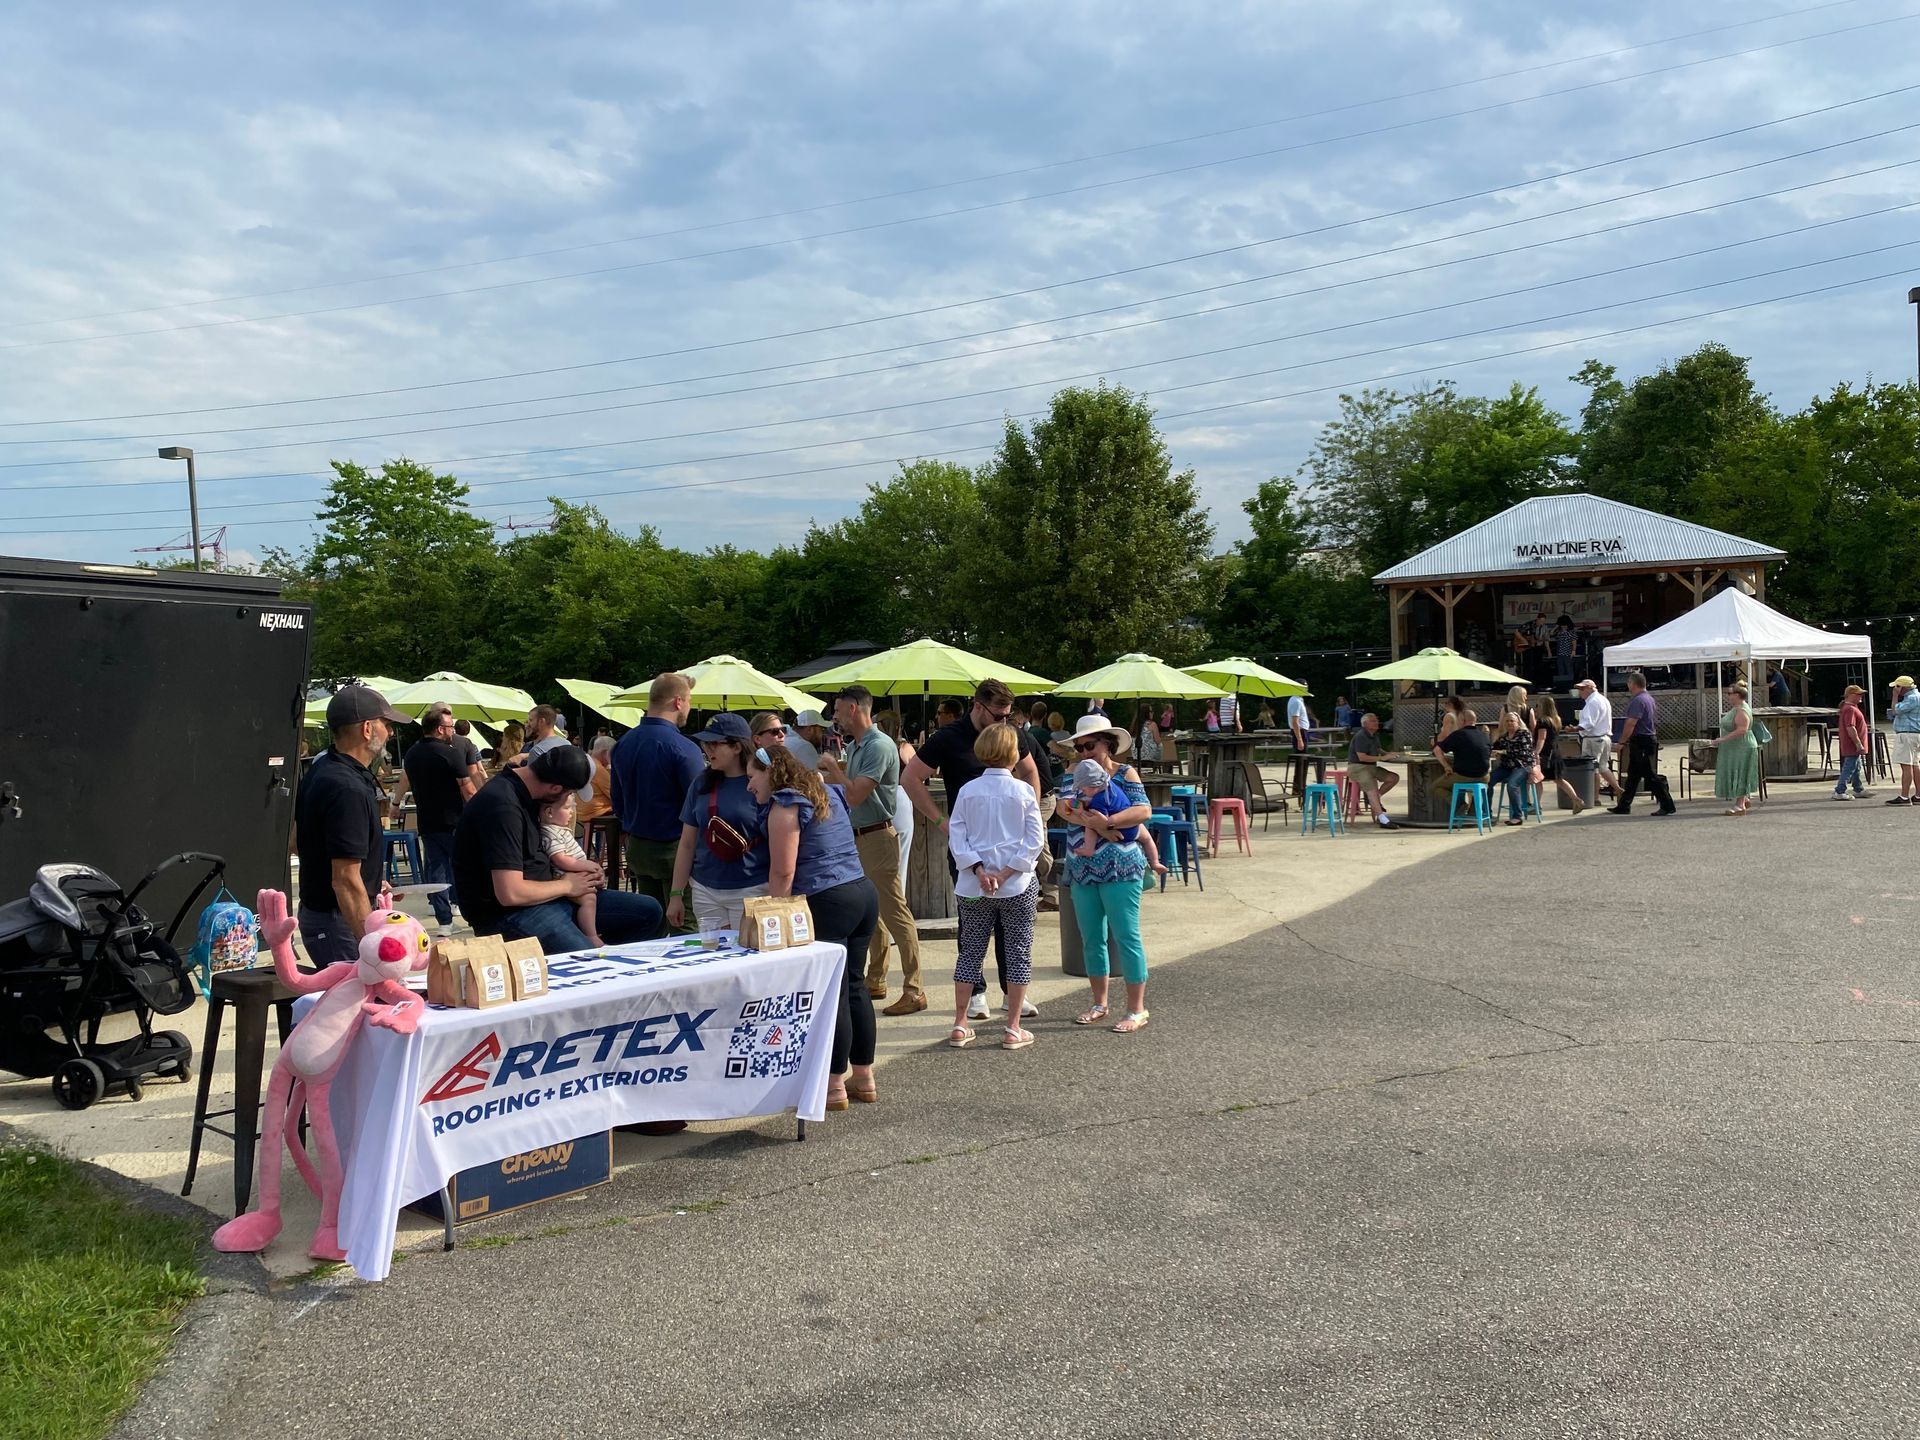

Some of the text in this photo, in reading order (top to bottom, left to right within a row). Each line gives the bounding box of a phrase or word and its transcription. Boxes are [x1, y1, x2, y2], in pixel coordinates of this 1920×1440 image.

[1517, 544, 1553, 557] MAIN
[1556, 541, 1587, 554] LINE
[259, 612, 304, 632] NEXHAUL
[492, 1008, 718, 1088] RETEX
[558, 1064, 688, 1100] EXTERIORS
[501, 1142, 574, 1175] chewy
